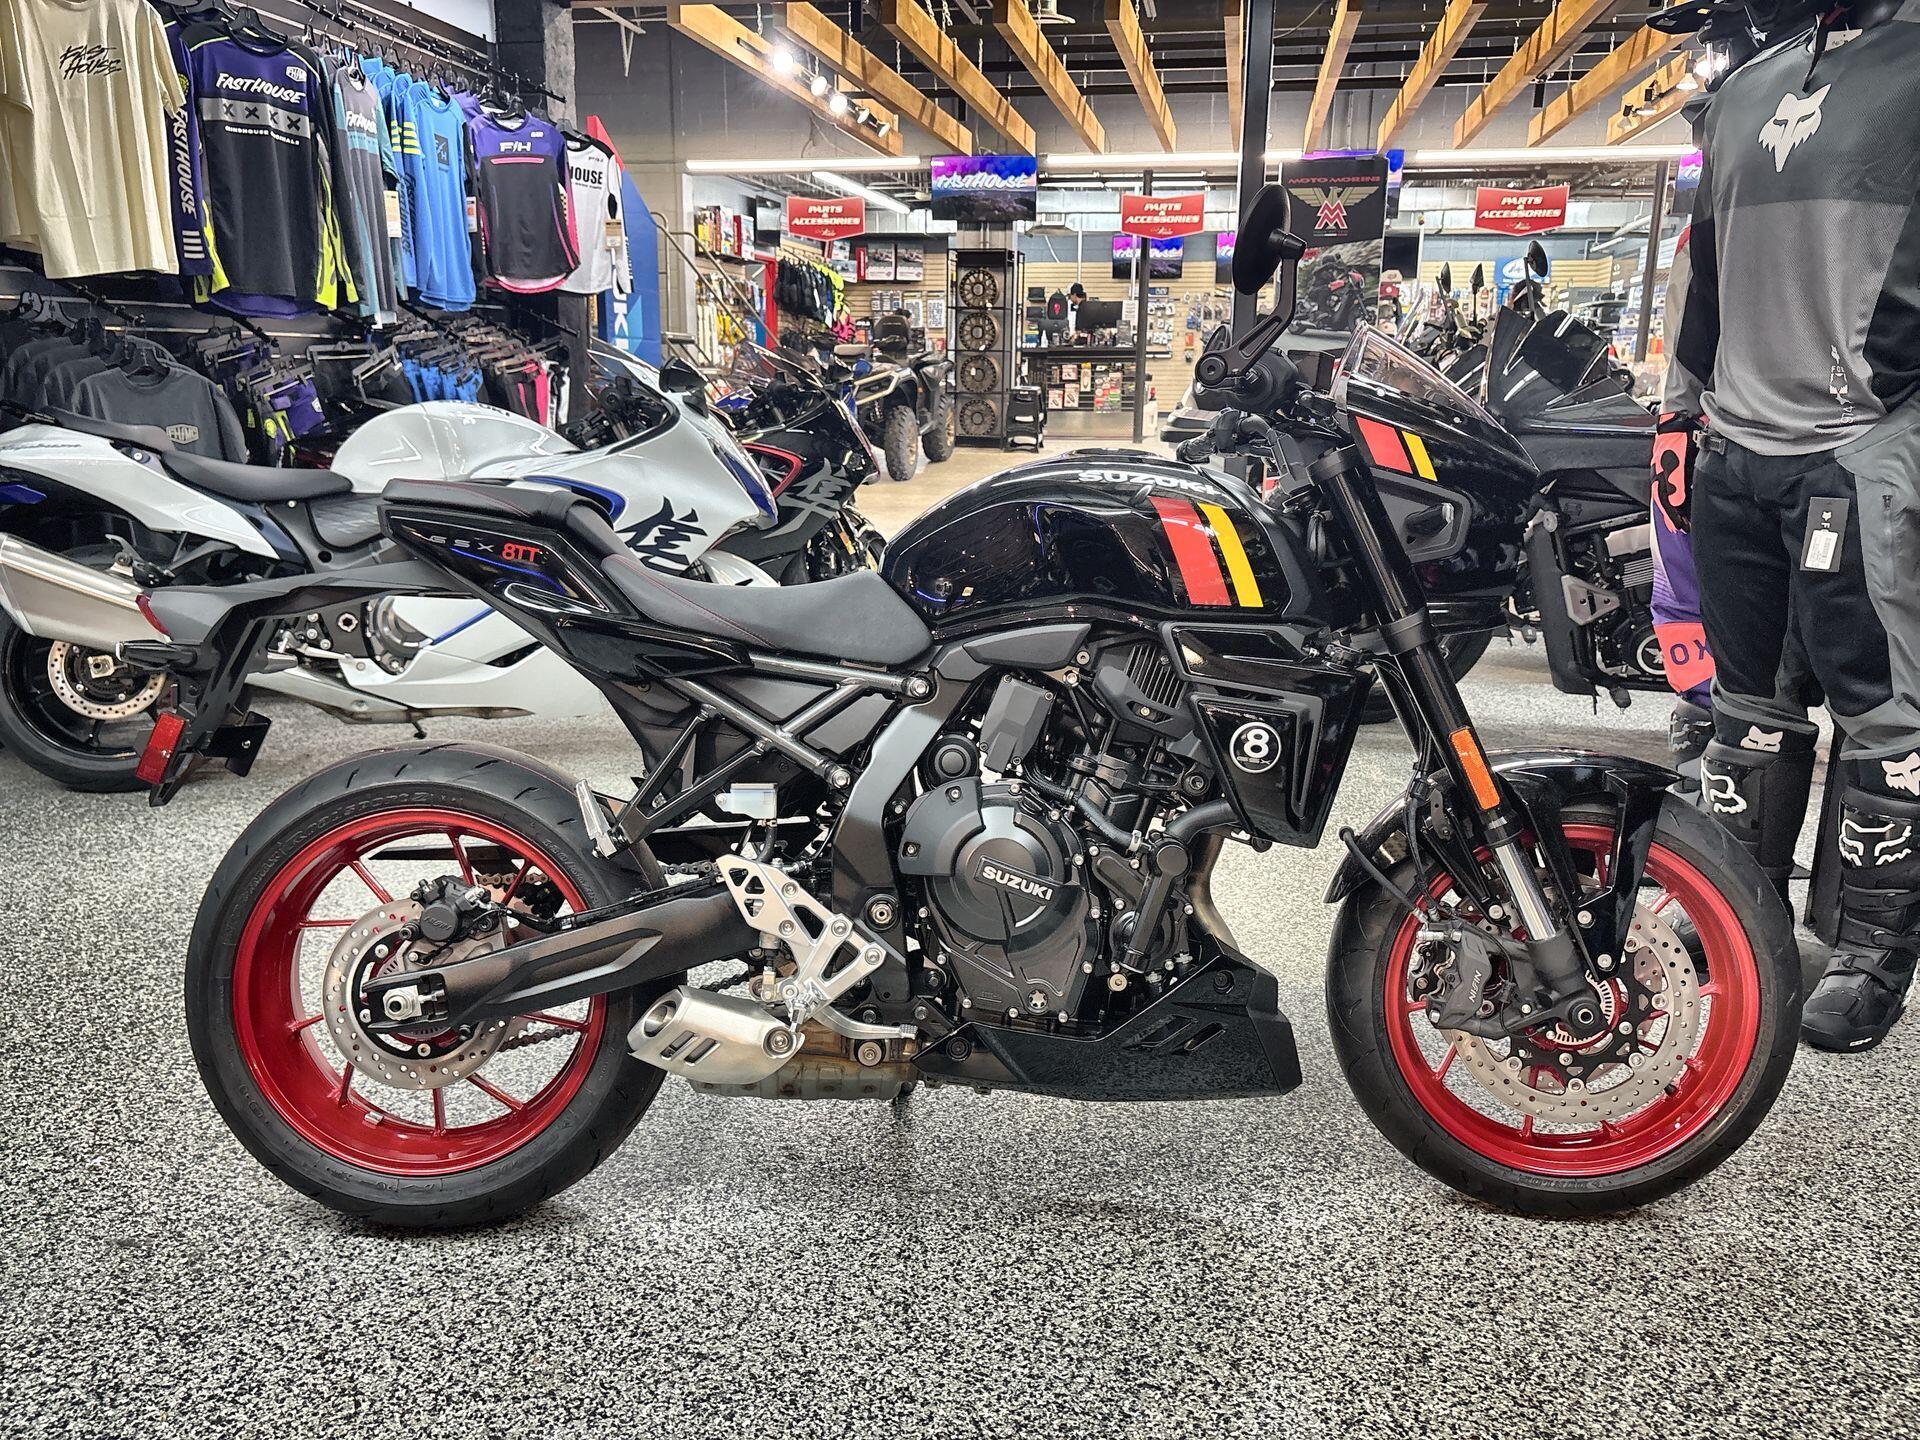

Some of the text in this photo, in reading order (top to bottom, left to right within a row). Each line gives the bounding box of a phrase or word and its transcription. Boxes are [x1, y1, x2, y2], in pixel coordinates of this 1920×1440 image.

[60, 45, 116, 68] FAST
[63, 58, 122, 80] HOUSE
[216, 72, 307, 103] FASTHOUSE
[500, 141, 532, 152] F/H
[172, 108, 197, 219] FASTHOUSE
[935, 167, 1030, 189] FASTHOUSE
[1288, 176, 1328, 184] MOTO
[808, 205, 843, 213] PARTS
[1144, 203, 1182, 211] PARTS
[1501, 196, 1543, 205] PARTS
[791, 217, 861, 226] ACCESSORIES
[1125, 215, 1200, 224] ACCESSORIES
[1479, 209, 1562, 219] ACCESSORIES
[1078, 470, 1220, 495] SUZUKI
[502, 543, 540, 562] 8TT
[1243, 728, 1270, 759] 8
[982, 865, 1053, 901] SUZUKI
